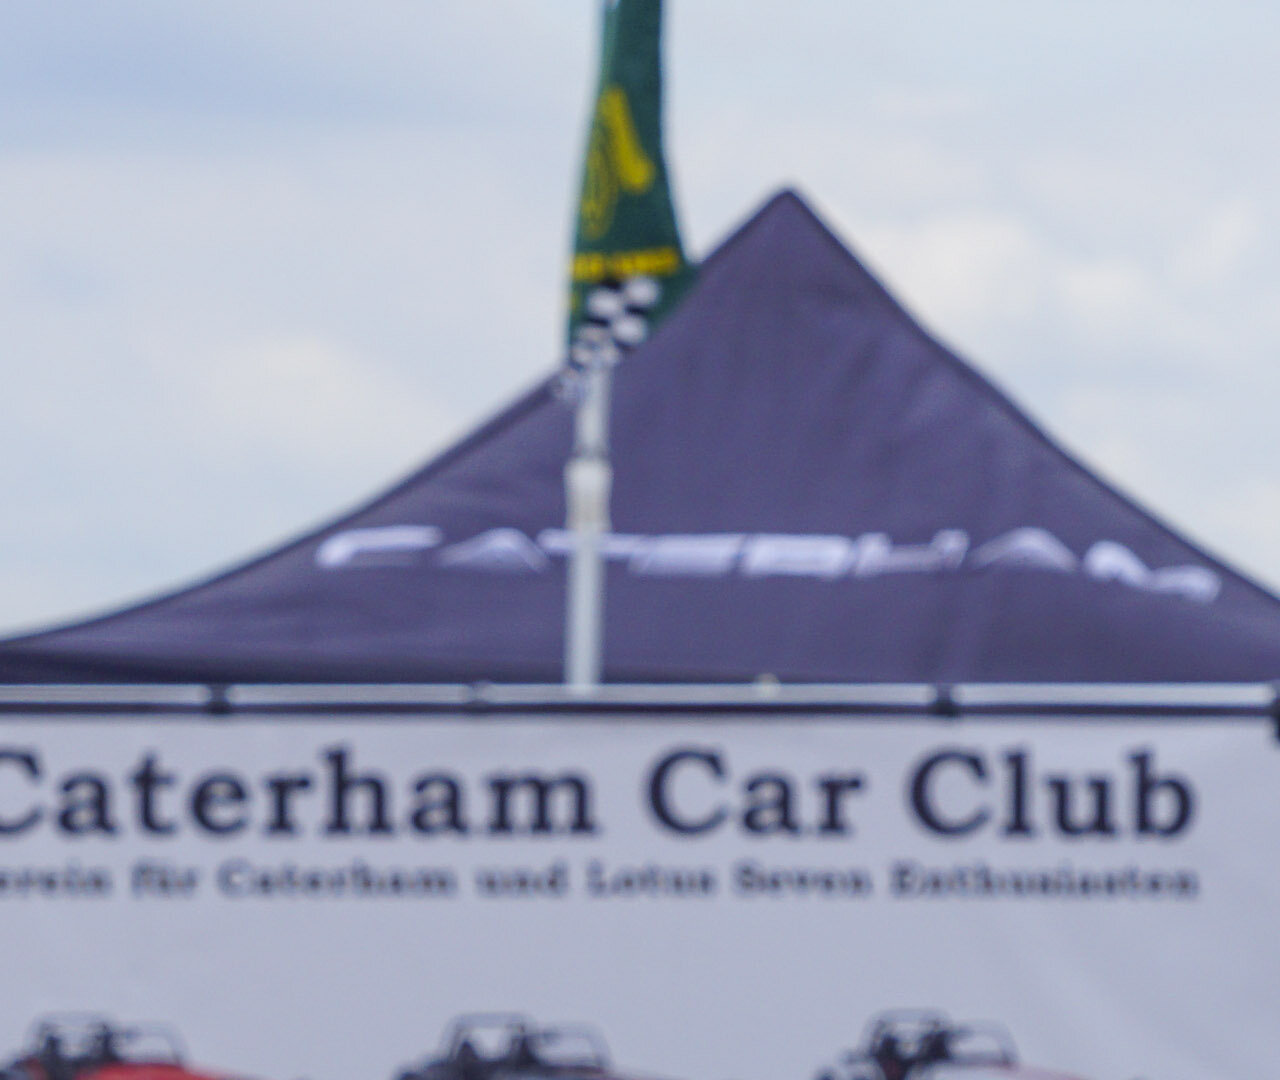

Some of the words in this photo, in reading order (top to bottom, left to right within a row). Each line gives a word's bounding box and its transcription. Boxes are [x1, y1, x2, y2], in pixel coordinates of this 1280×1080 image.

[647, 748, 864, 837] Car
[907, 746, 1196, 838] Club
[217, 859, 456, 897] Caterham
[475, 860, 568, 896] und
[586, 861, 715, 897] Lotus
[734, 861, 872, 896] Seven
